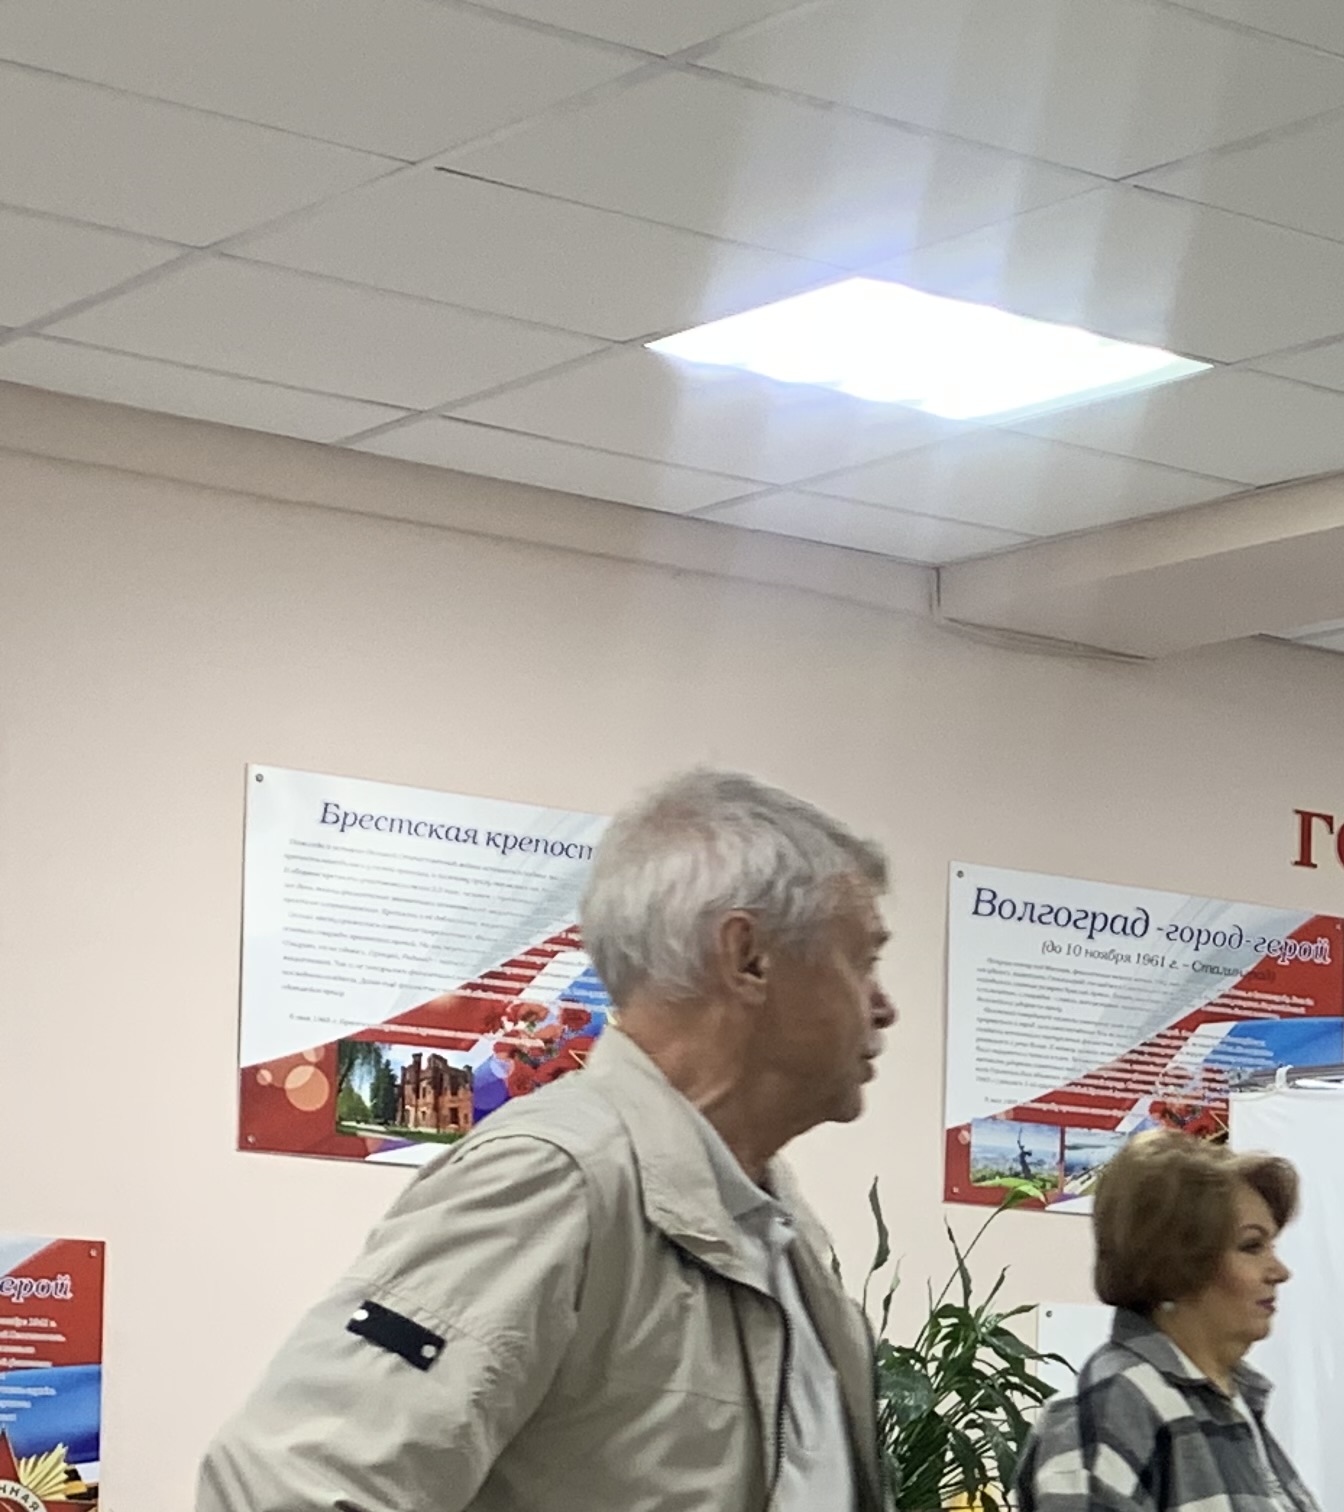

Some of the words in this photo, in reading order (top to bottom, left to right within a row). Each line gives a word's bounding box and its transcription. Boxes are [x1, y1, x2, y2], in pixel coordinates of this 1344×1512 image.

[319, 801, 480, 846] Брестская
[485, 830, 594, 861] крепост
[971, 887, 1151, 940] Волгоград
[1041, 940, 1062, 956] (до
[1066, 943, 1082, 957] 10
[1084, 948, 1132, 966] ноября
[1136, 952, 1167, 968] 1961
